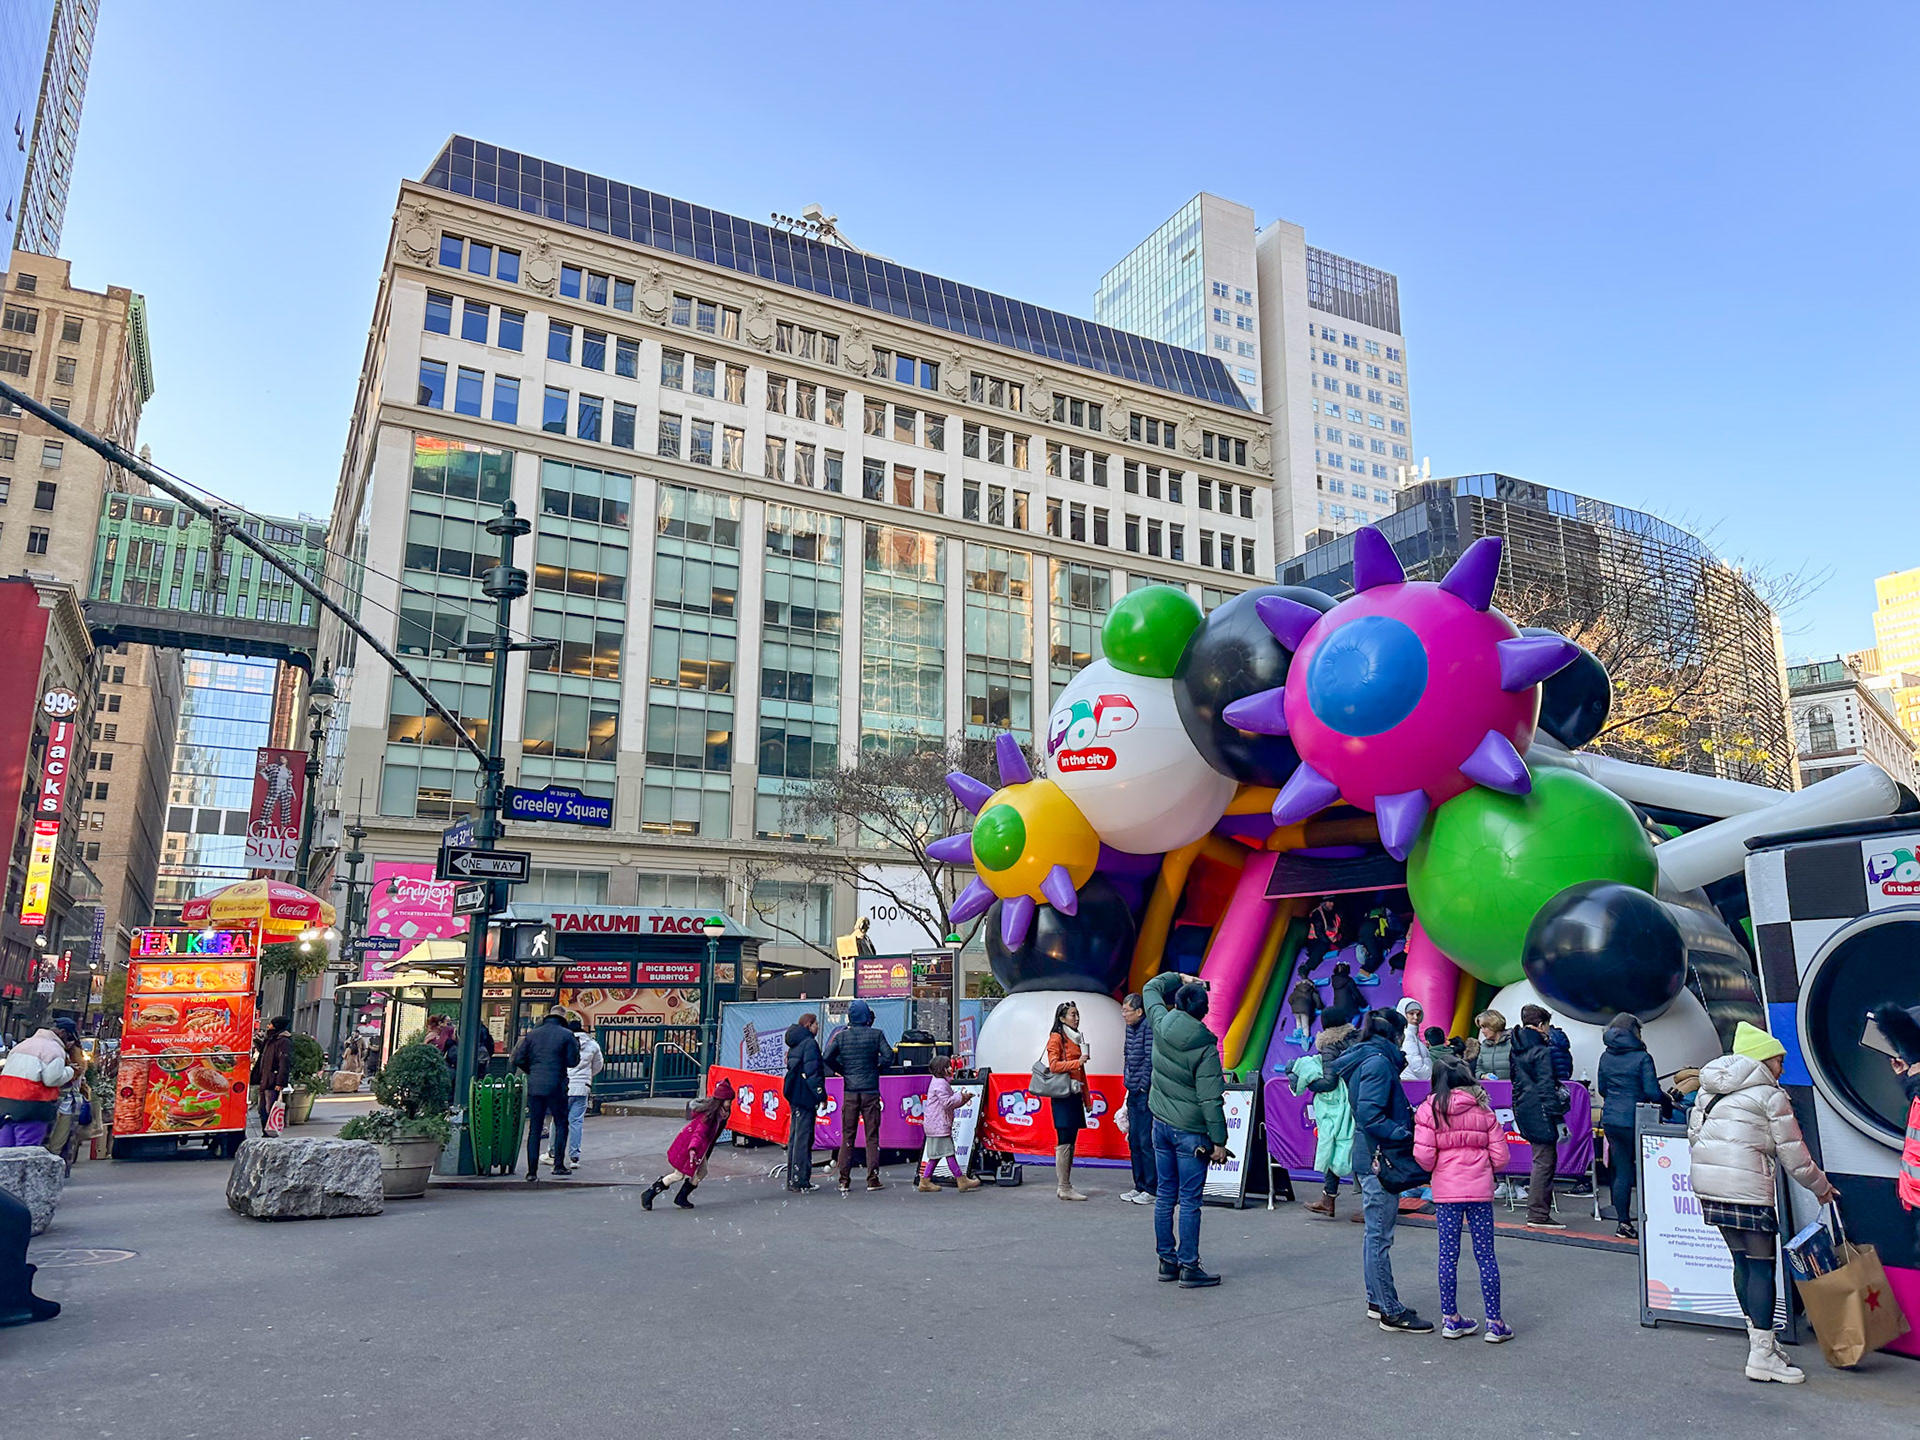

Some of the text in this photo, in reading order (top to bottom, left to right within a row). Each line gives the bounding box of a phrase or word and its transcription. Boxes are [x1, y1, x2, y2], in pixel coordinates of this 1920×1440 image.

[1047, 694, 1139, 757] POP
[42, 722, 66, 811] jacks
[1061, 753, 1109, 767] in the city
[513, 795, 608, 820] Greeley Square
[249, 819, 297, 840] Give
[245, 838, 297, 862] Style
[461, 858, 516, 871] ONE WAY
[391, 869, 454, 911] Candytopi
[460, 891, 482, 905] ONE WAY
[551, 914, 640, 932] TAKUMI
[145, 933, 178, 953] EN
[354, 940, 377, 950] Greeley
[378, 941, 398, 950] Square
[597, 1015, 662, 1025] TAKUMI TACO
[999, 1090, 1040, 1117] POP
[1224, 1161, 1241, 1172] NOW
